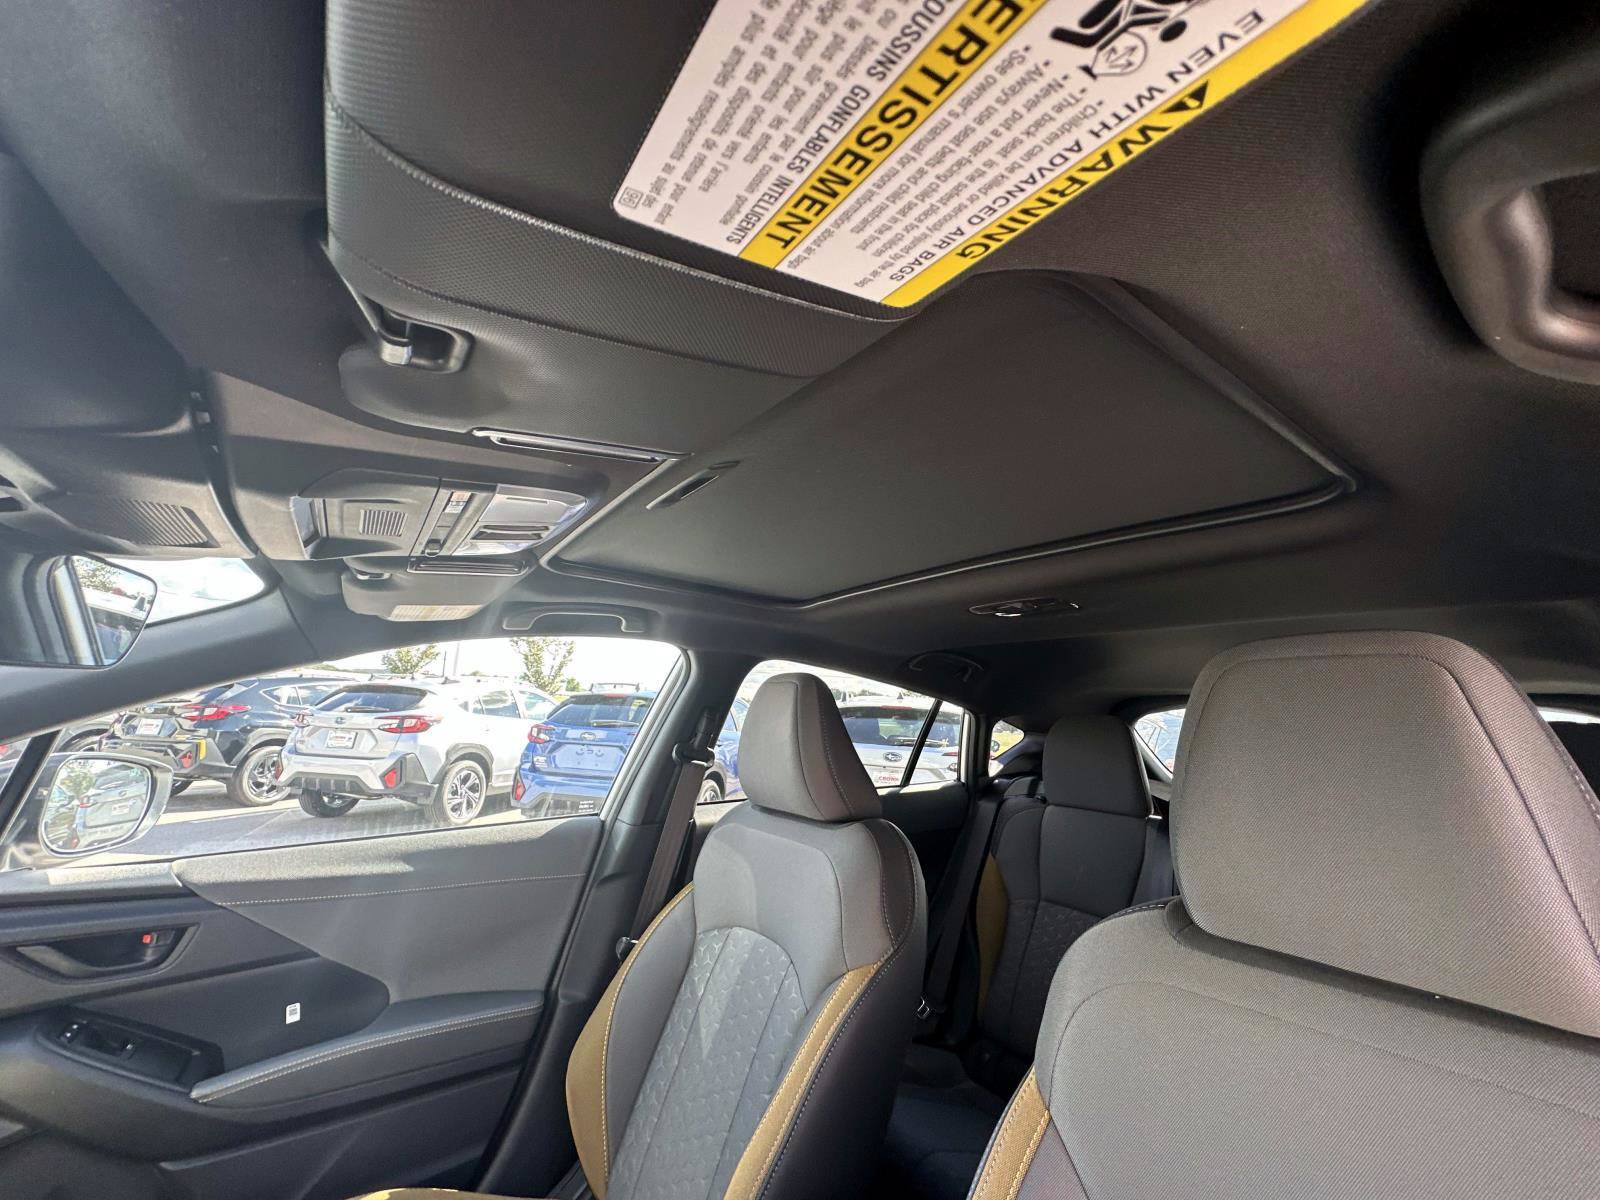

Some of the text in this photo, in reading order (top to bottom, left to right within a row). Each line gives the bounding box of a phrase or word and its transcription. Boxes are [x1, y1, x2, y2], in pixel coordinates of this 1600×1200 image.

[994, 49, 1027, 76] See
[947, 74, 998, 120] owner's
[725, 0, 949, 245] OUSSINS GONFLABLES INTELLIGENTS
[766, 0, 1025, 249] ERTISSEMENT
[909, 117, 952, 157] manual
[1041, 104, 1099, 146] Children
[849, 63, 1045, 235] Always use seat belts and child restraints
[889, 9, 1264, 282] EVEN WITH ADVANCED AIR BAGS
[896, 152, 918, 169] for
[1019, 144, 1045, 163] can
[855, 78, 1065, 252] Never put a rear-facing child seat in the front
[871, 92, 1083, 258] The back seat is the safest place for children
[871, 166, 900, 190] more
[1004, 160, 1025, 175] be
[955, 124, 1171, 259] WARNING
[965, 193, 981, 205] or
[977, 172, 1010, 197] killed
[829, 188, 880, 230] information
[925, 202, 969, 234] seriously
[810, 227, 836, 248] about
[899, 231, 933, 255] injured
[877, 260, 895, 271] the
[888, 252, 906, 262] by
